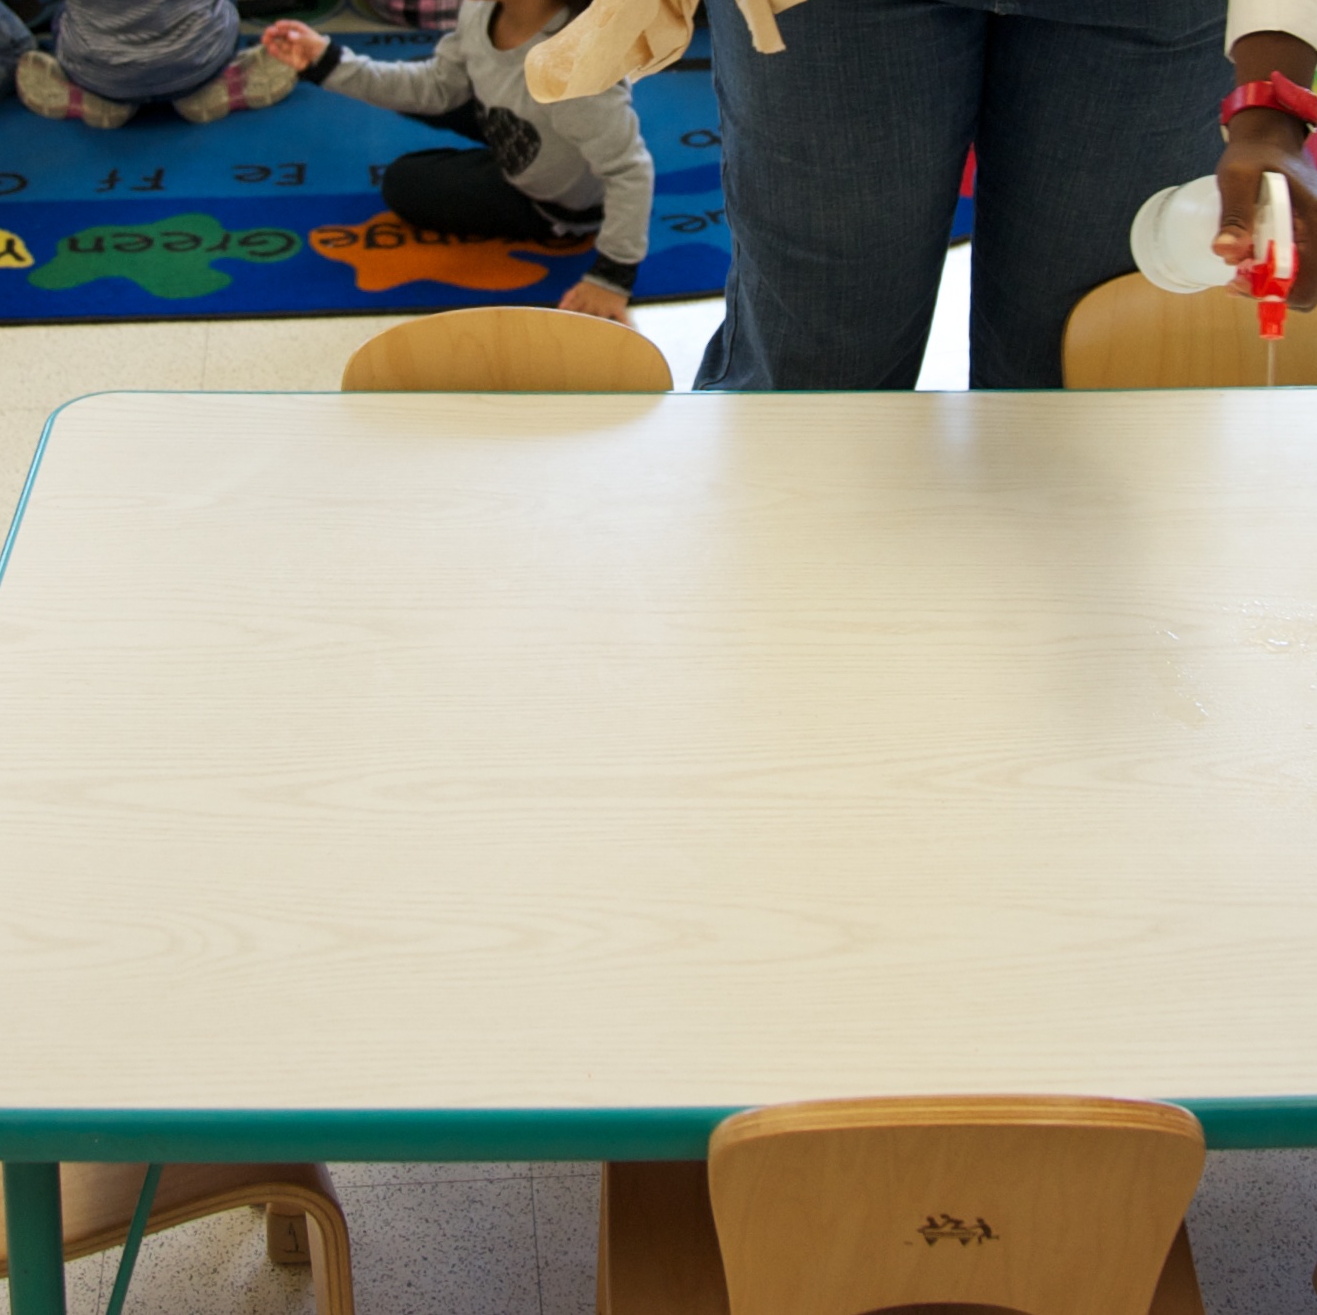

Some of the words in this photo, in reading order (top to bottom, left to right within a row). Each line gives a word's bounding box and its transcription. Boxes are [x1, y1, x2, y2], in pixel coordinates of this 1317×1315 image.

[96, 168, 165, 192] Ff
[232, 163, 307, 187] Ee
[66, 225, 298, 260] Green
